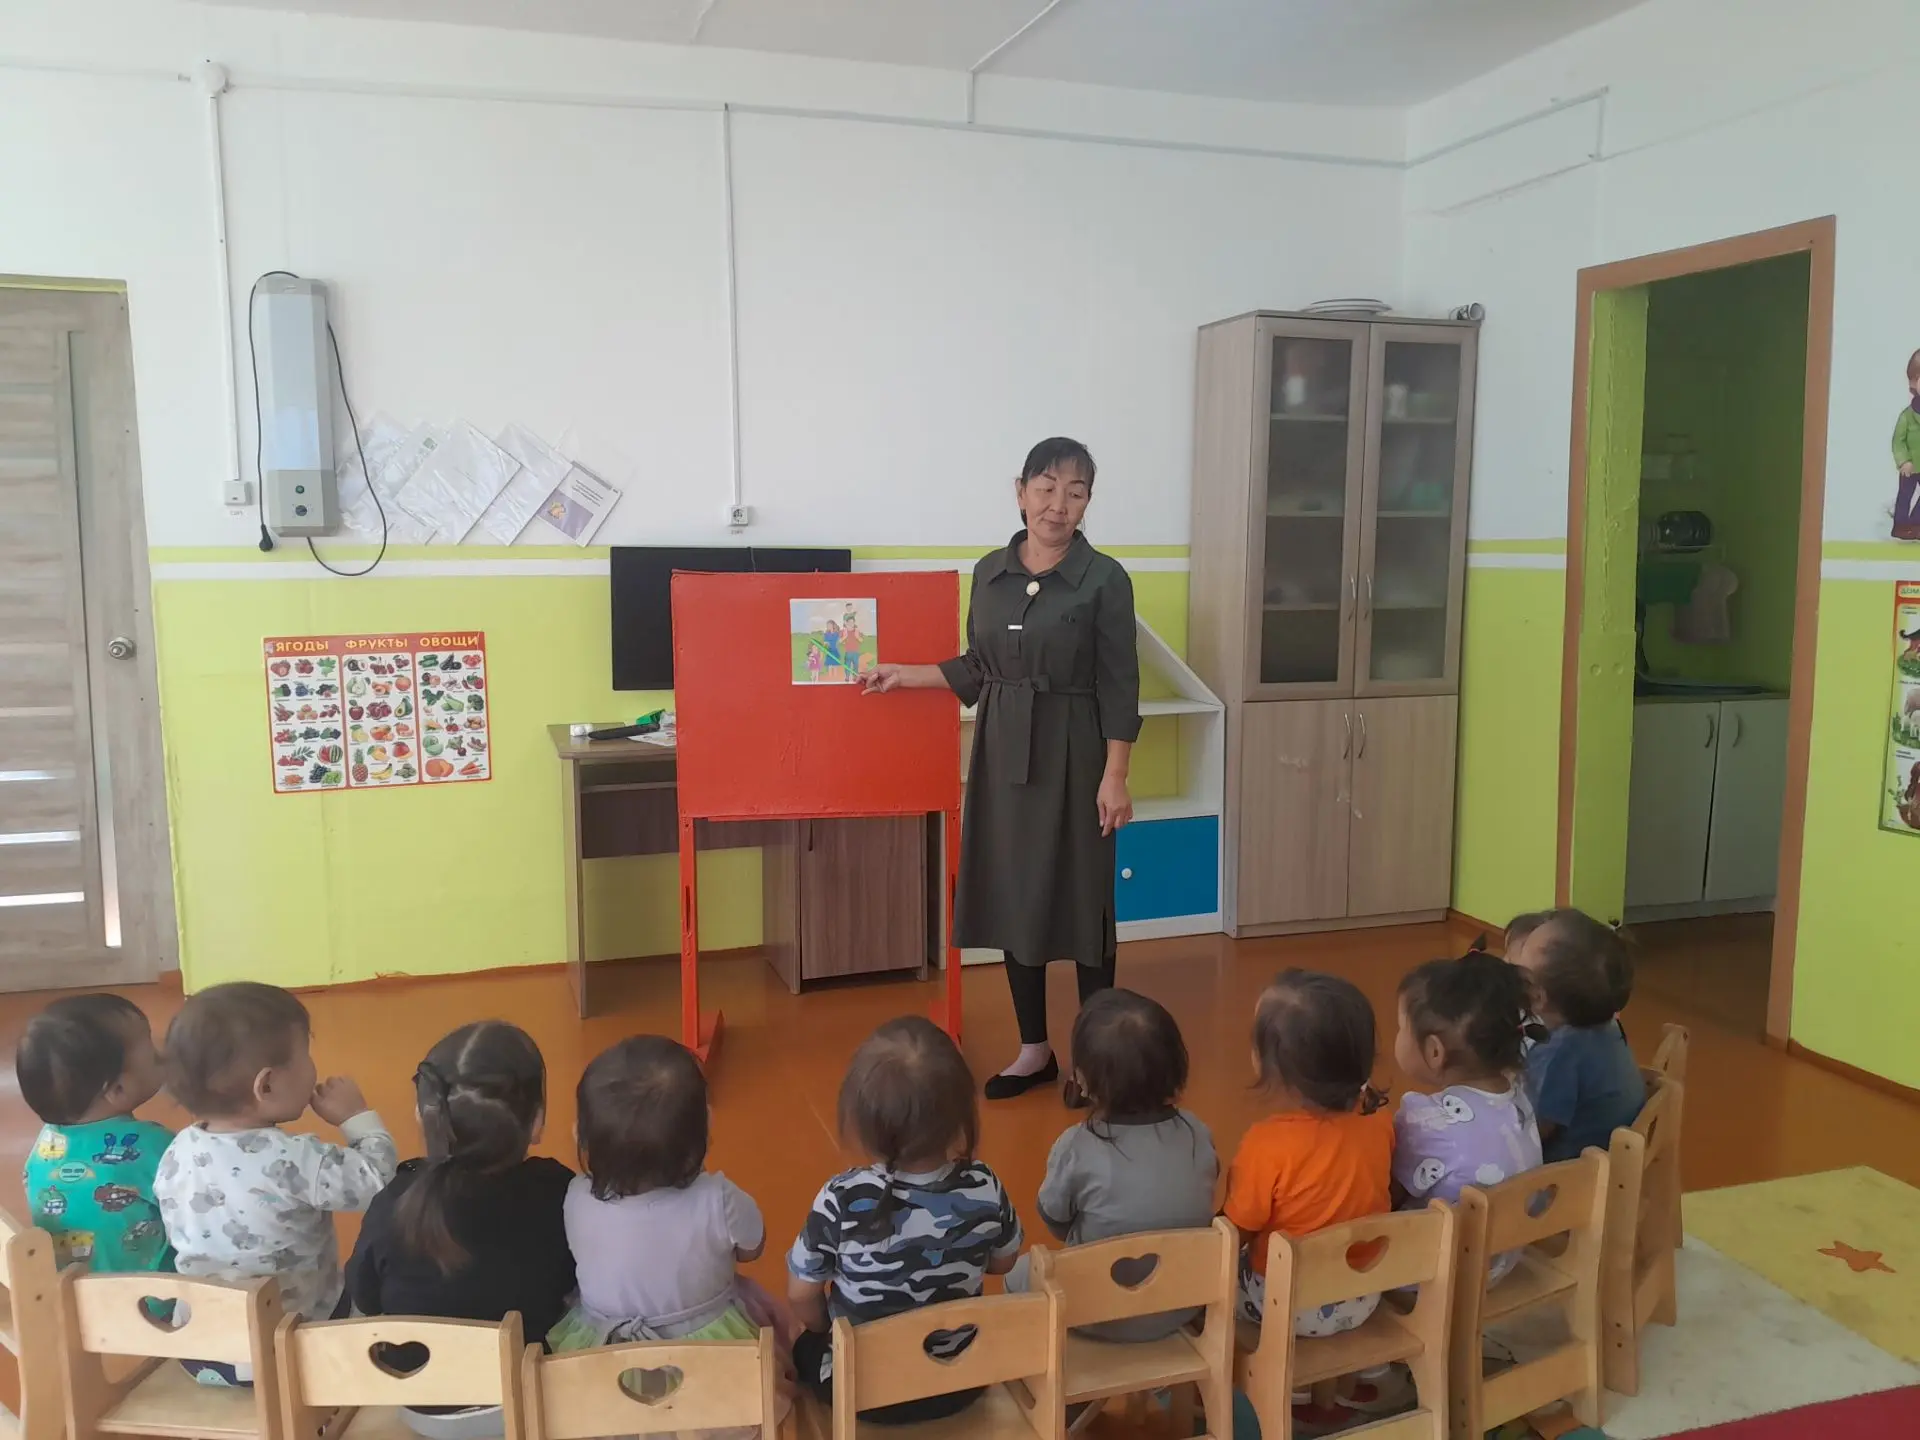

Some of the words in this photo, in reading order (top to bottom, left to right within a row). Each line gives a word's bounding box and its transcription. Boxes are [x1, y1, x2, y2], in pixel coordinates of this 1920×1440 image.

[276, 641, 329, 652] ЯГОДЫ
[345, 638, 408, 650] ФРУКТЫ
[420, 635, 478, 648] ОВОЩИ
